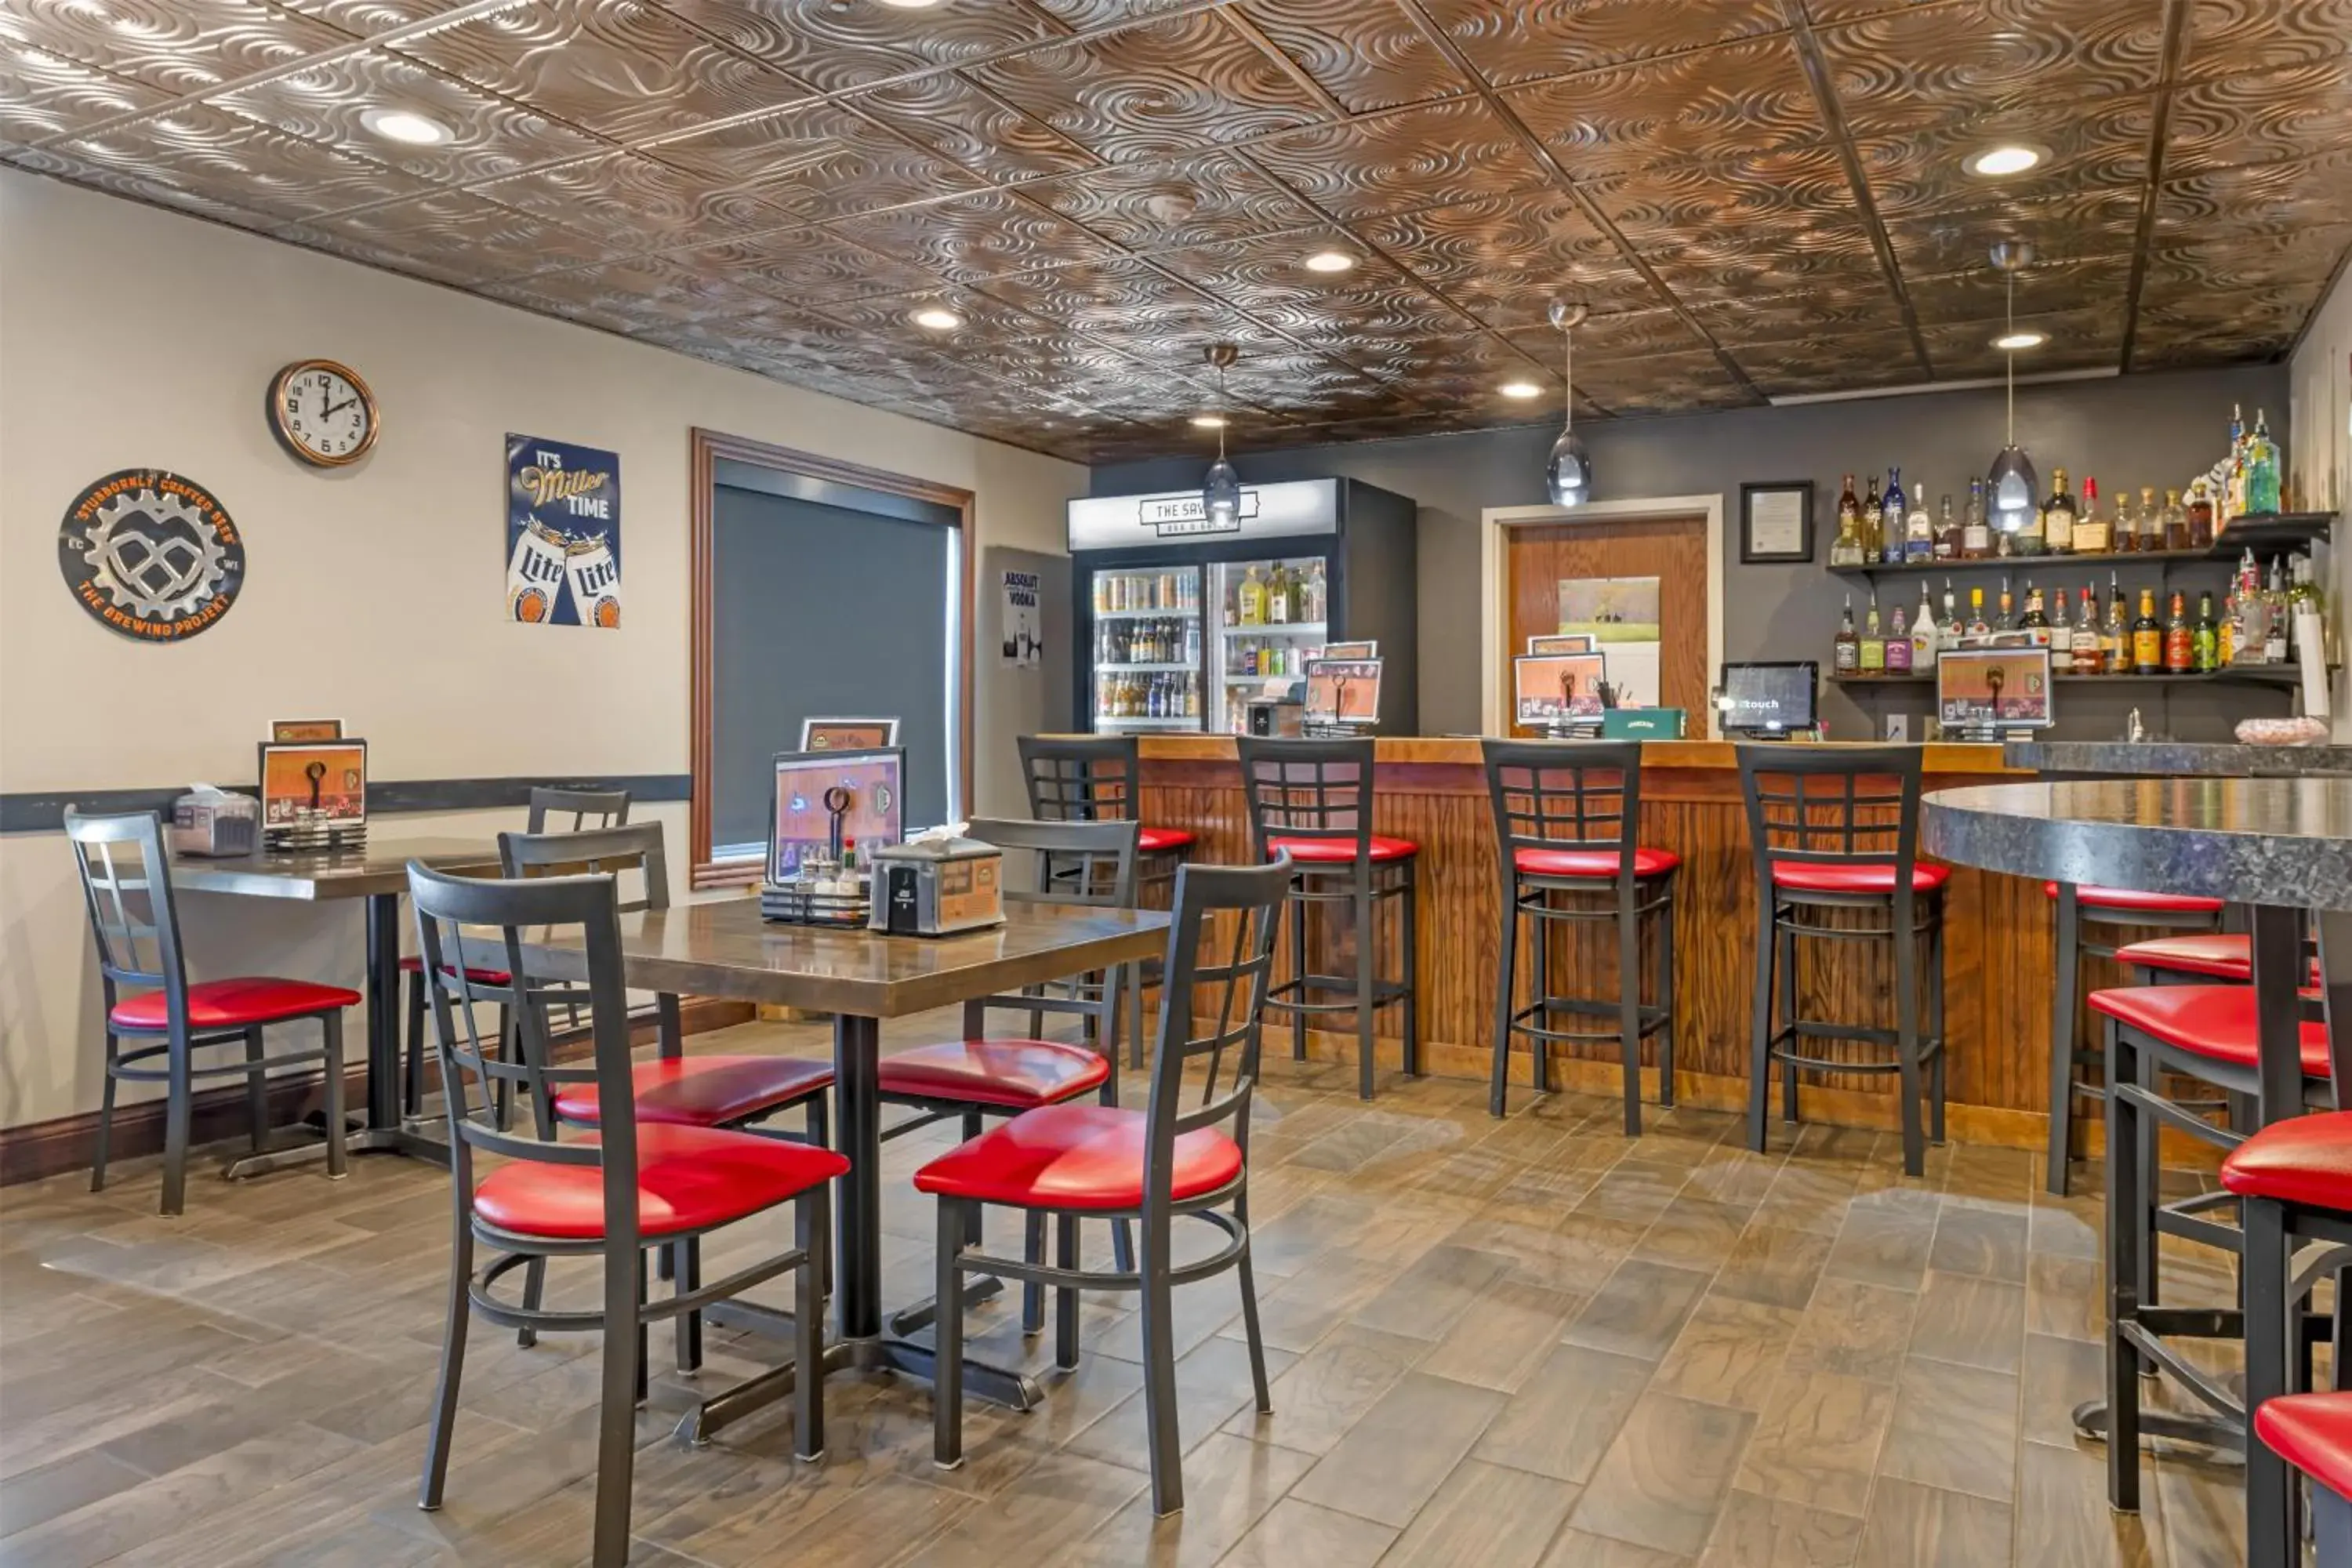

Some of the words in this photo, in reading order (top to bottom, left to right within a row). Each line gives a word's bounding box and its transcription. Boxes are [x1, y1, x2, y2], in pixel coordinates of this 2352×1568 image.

[304, 377, 311, 388] 11
[318, 374, 331, 390] 12
[339, 384, 343, 394] 1
[292, 385, 303, 397] 10
[288, 398, 299, 413] 9
[292, 419, 301, 431] 8
[352, 413, 361, 427] 3
[304, 433, 311, 441] 7
[349, 430, 355, 440] 4
[321, 438, 331, 452] 6
[339, 441, 346, 451] 5
[536, 449, 562, 469] IT'S
[521, 466, 610, 507] Miller
[161, 478, 213, 511] CRAFTED
[567, 495, 610, 519] TIME
[1156, 505, 1178, 517] THE
[519, 544, 564, 583] Lite
[573, 560, 615, 597] Lite
[78, 579, 105, 609] THE
[103, 605, 172, 636] BREWING
